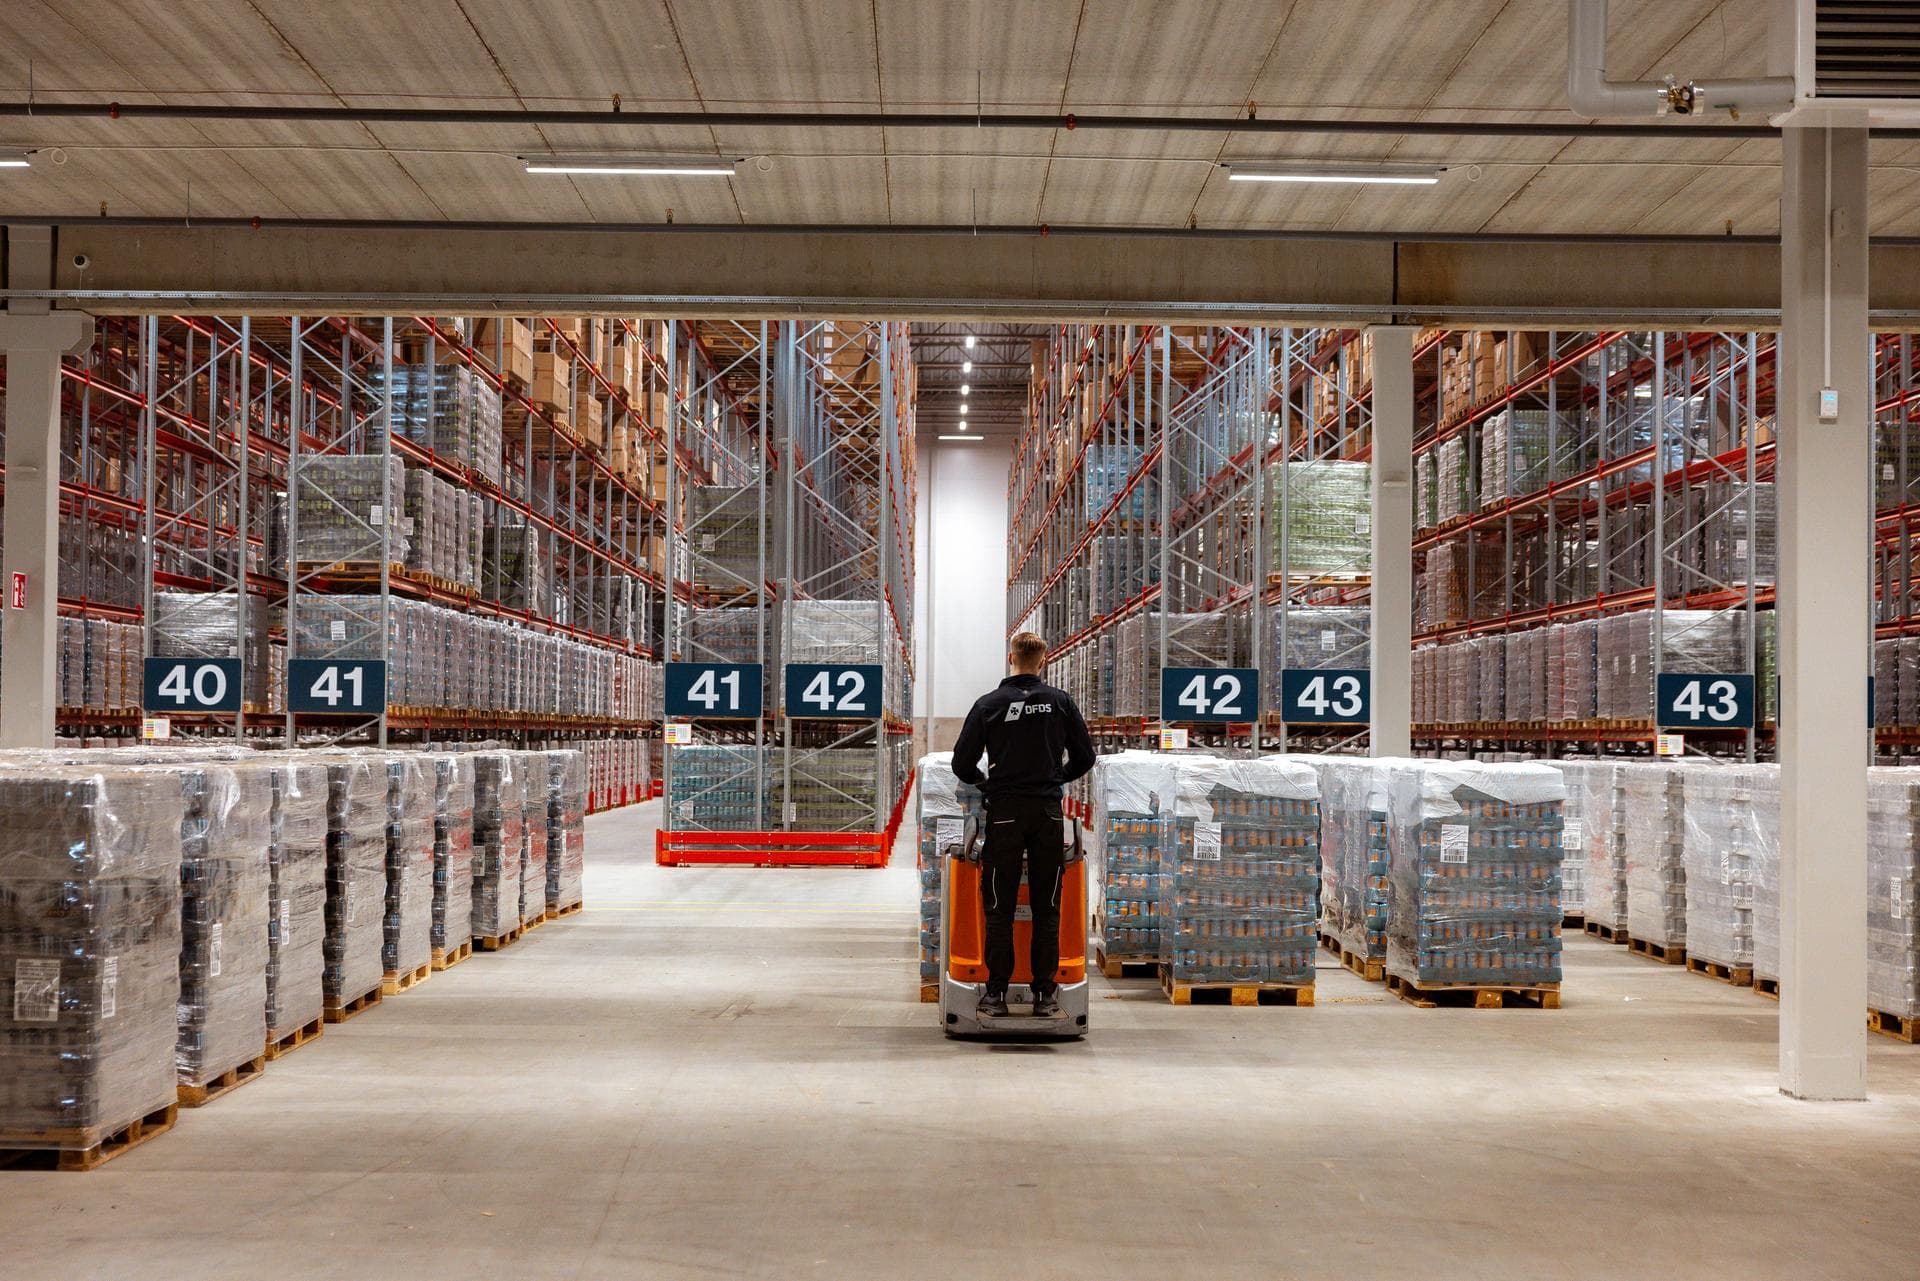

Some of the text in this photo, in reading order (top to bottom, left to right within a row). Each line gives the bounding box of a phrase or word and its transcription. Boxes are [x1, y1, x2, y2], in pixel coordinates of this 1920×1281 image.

[159, 665, 226, 705] 40
[311, 667, 362, 705] 41
[688, 671, 739, 709] 41
[803, 671, 865, 710] 42
[1179, 675, 1241, 714] 42
[1298, 676, 1362, 716] 43
[1673, 681, 1737, 721] 43
[1025, 703, 1052, 714] DFDS
